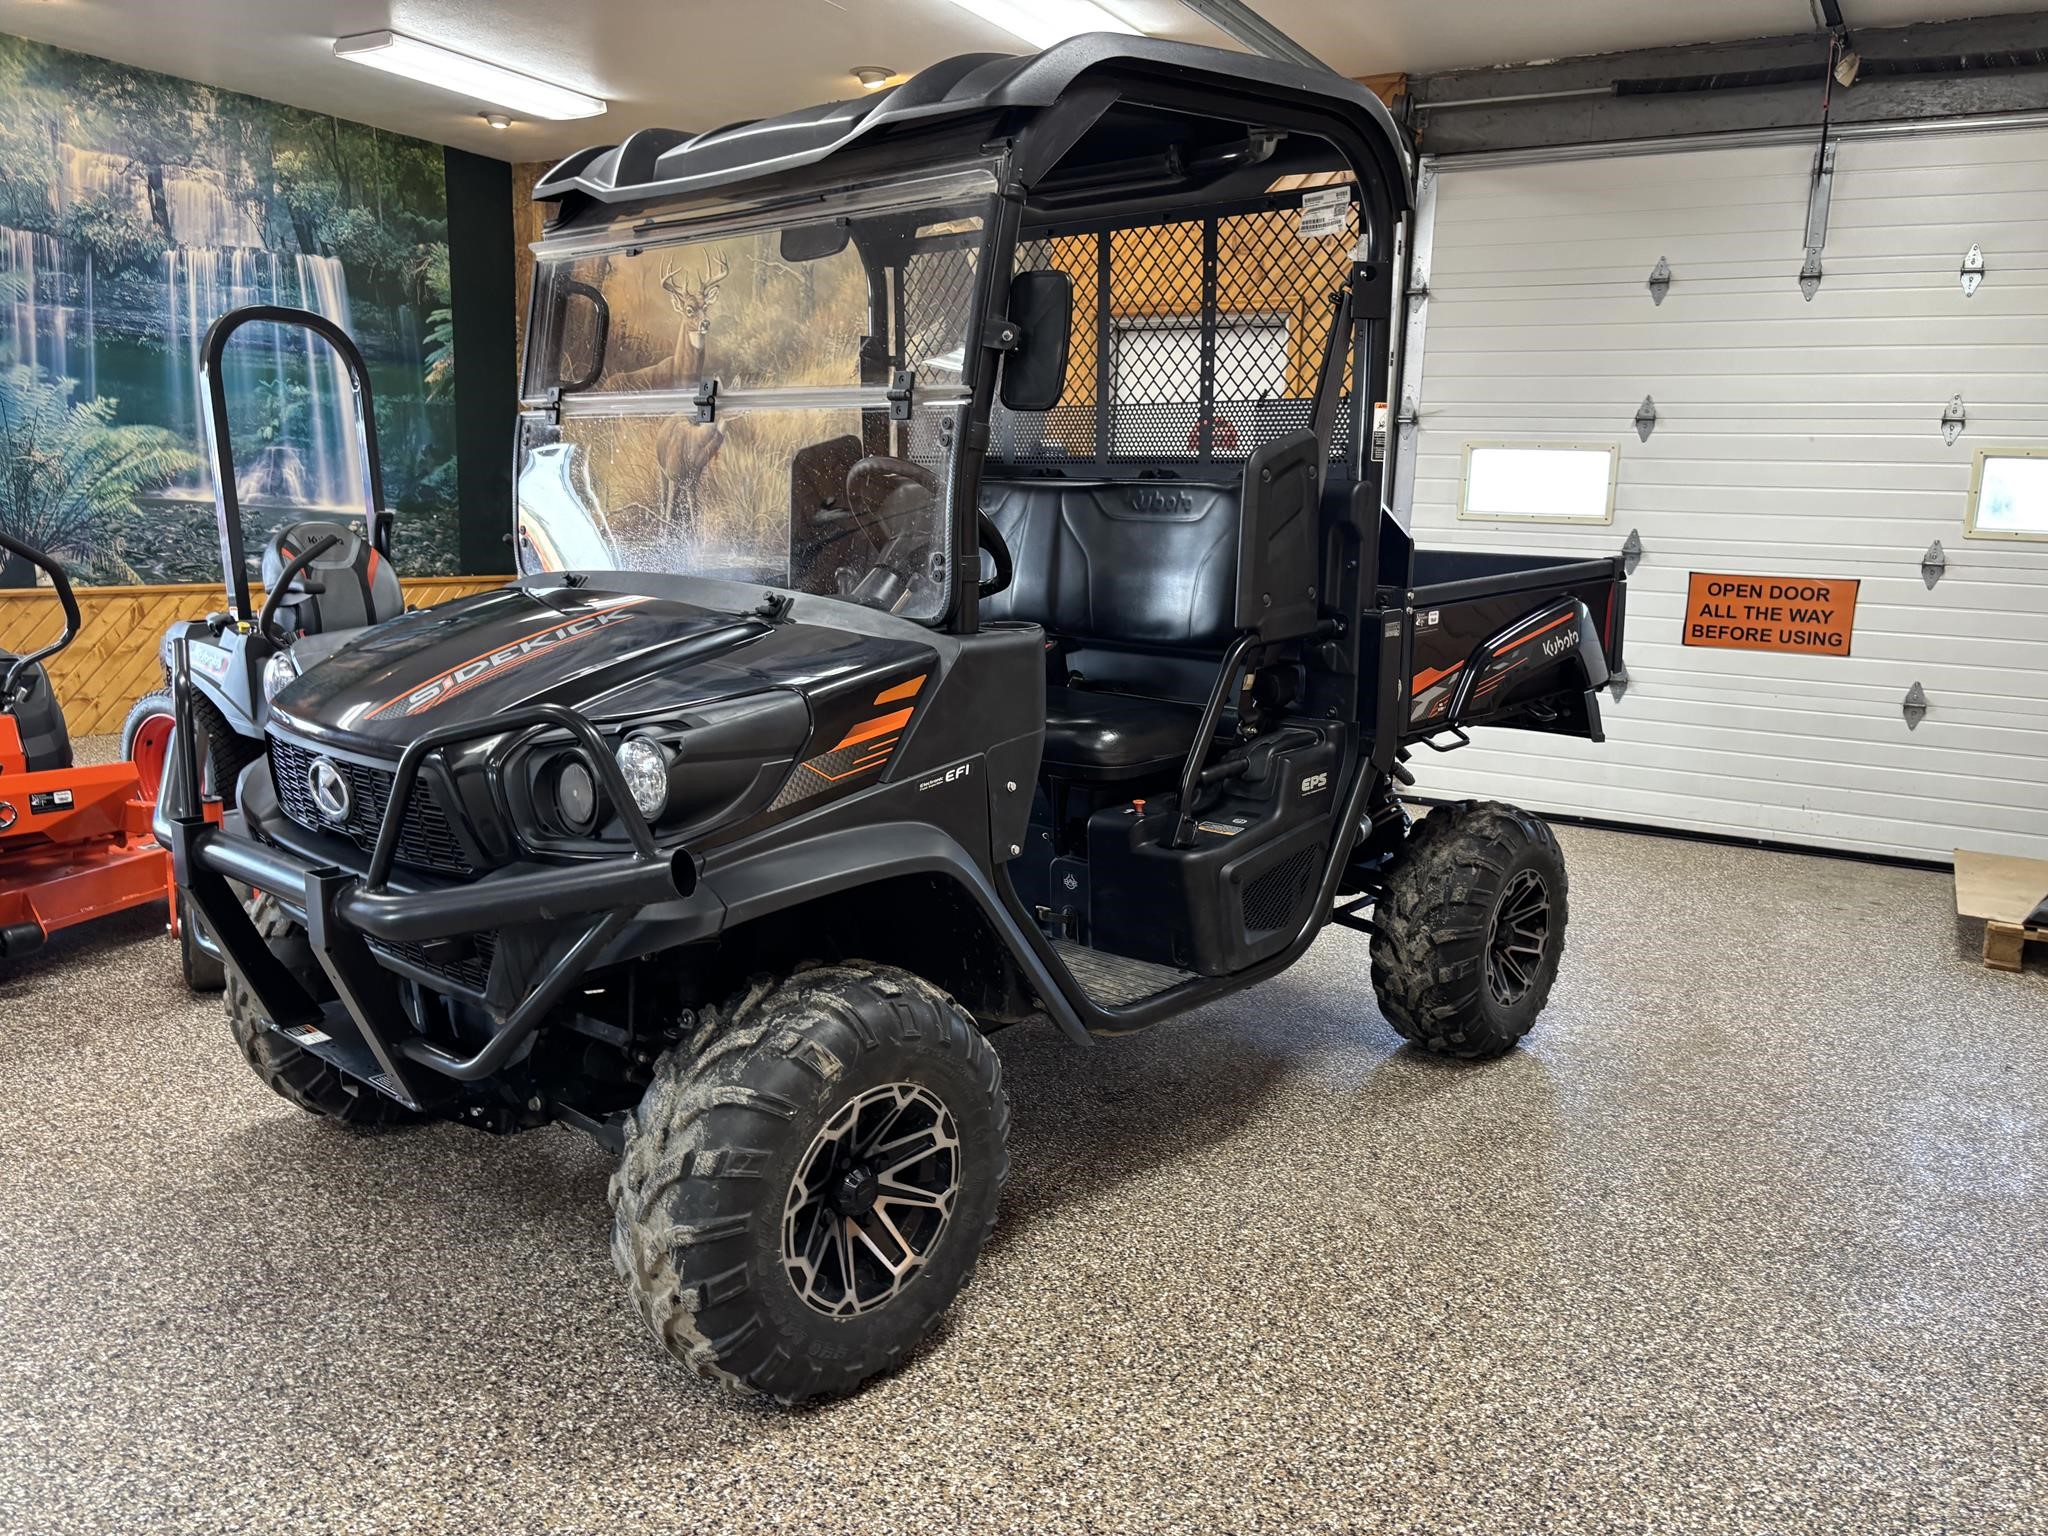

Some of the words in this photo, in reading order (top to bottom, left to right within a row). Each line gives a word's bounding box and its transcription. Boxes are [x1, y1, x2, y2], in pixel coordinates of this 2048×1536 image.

[1707, 582, 1763, 599] OPEN
[1769, 585, 1830, 602] DOOR
[1699, 603, 1737, 619] ALL
[1743, 605, 1783, 621] THE
[1789, 608, 1835, 624] WAY
[1542, 629, 1579, 657] Kubota
[1691, 624, 1773, 642] BEFORE
[1779, 630, 1843, 647] USING
[407, 609, 633, 706] SIDEKICK
[945, 764, 970, 783] EFI
[1301, 772, 1328, 791] EPS
